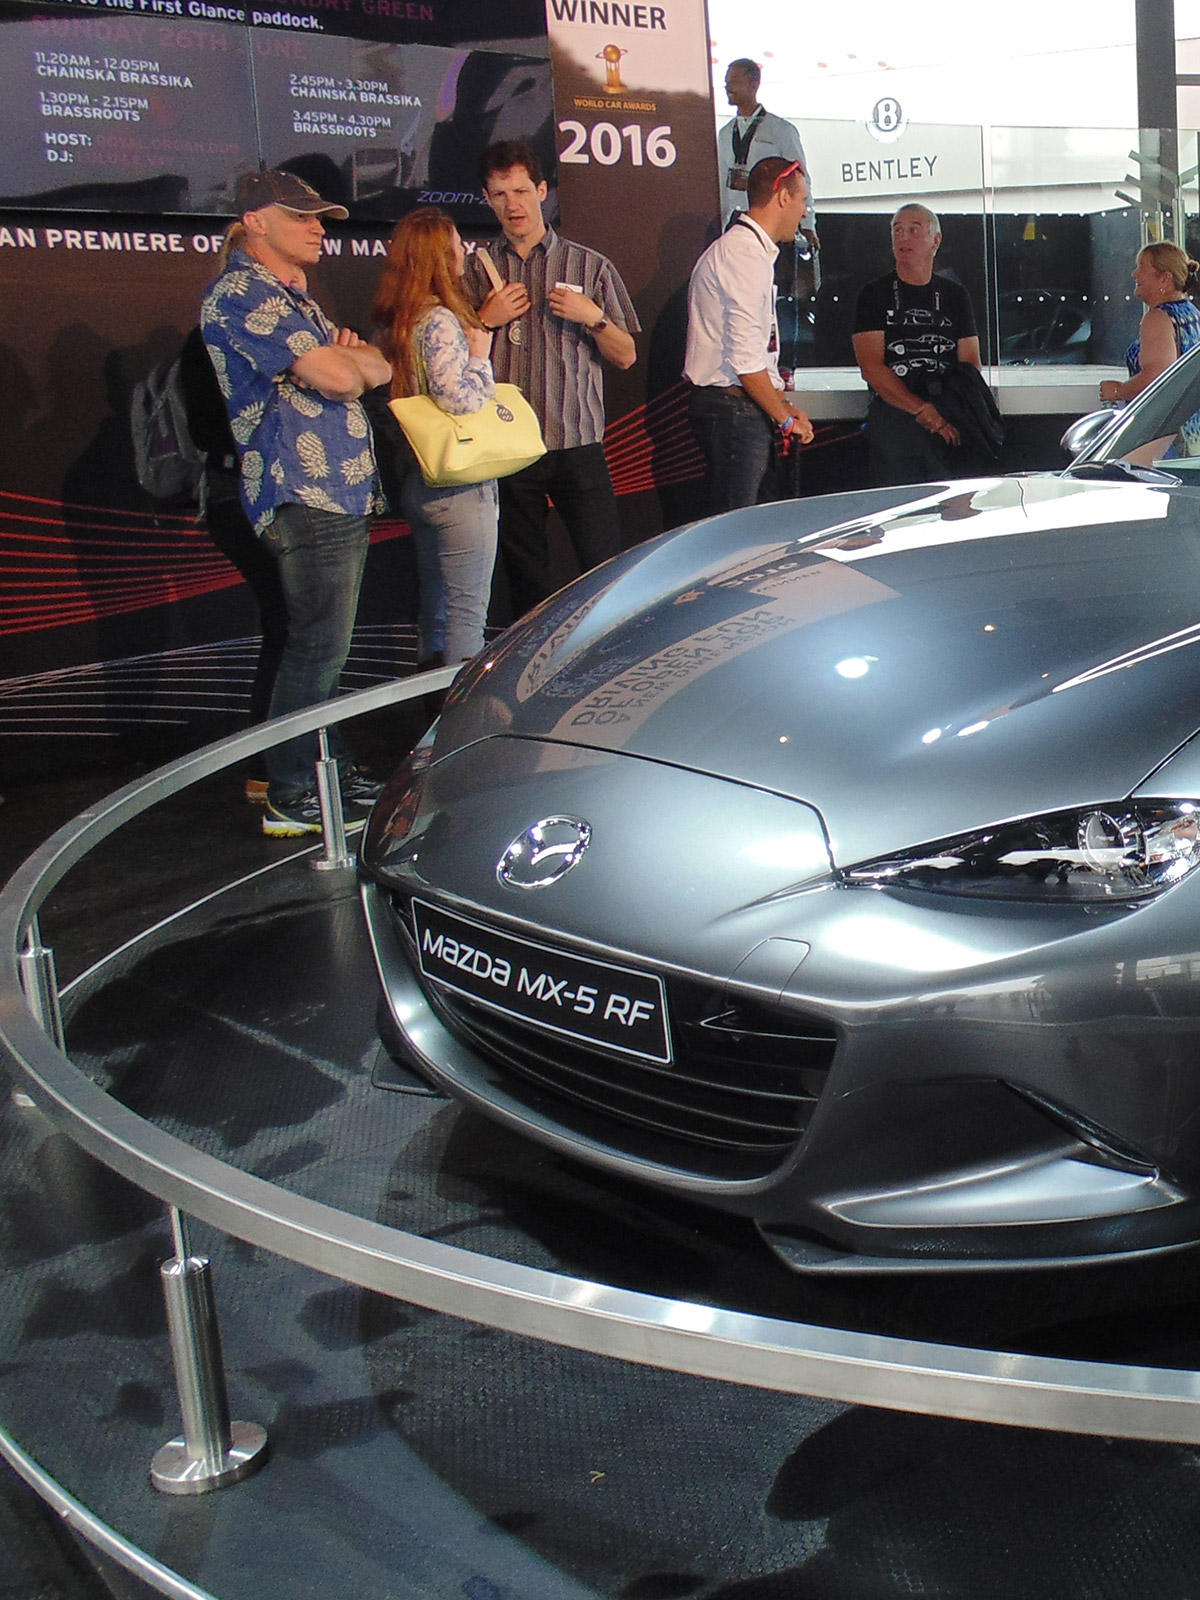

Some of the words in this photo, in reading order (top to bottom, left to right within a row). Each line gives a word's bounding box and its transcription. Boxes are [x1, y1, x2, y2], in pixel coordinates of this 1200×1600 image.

[140, 0, 183, 15] First
[188, 3, 246, 21] Glance
[252, 9, 324, 30] paddock.
[361, 0, 434, 21] GREEN
[552, 0, 667, 30] WINNER
[35, 52, 91, 67] 11.20AM
[104, 57, 160, 72] 12.05PM
[37, 65, 116, 82] CHAINSKA
[119, 72, 194, 88] BRASSIKA
[289, 74, 334, 88] 2.45PM
[346, 79, 389, 93] 3.30PM
[40, 91, 89, 105] 1.30PM
[103, 96, 149, 110] 2.15PM
[290, 86, 357, 102] CHAINSKA
[360, 92, 422, 107] BRASSIKA
[573, 98, 604, 109] WORLD
[605, 100, 622, 110] CAR
[623, 101, 657, 111] AWARDS
[42, 105, 141, 122] BRASSROOTS
[292, 110, 338, 124] 3.45PM
[348, 115, 391, 128] 4.30PM
[45, 132, 92, 147] HOST:
[293, 122, 377, 138] BRASSROOTS
[558, 120, 677, 168] 2016
[47, 150, 74, 163] DJ:
[841, 155, 937, 182] BENTLEY
[46, 228, 185, 253] PREMIERE
[192, 234, 225, 253] OF
[517, 966, 598, 1015] MX-5
[604, 994, 655, 1027] RF
